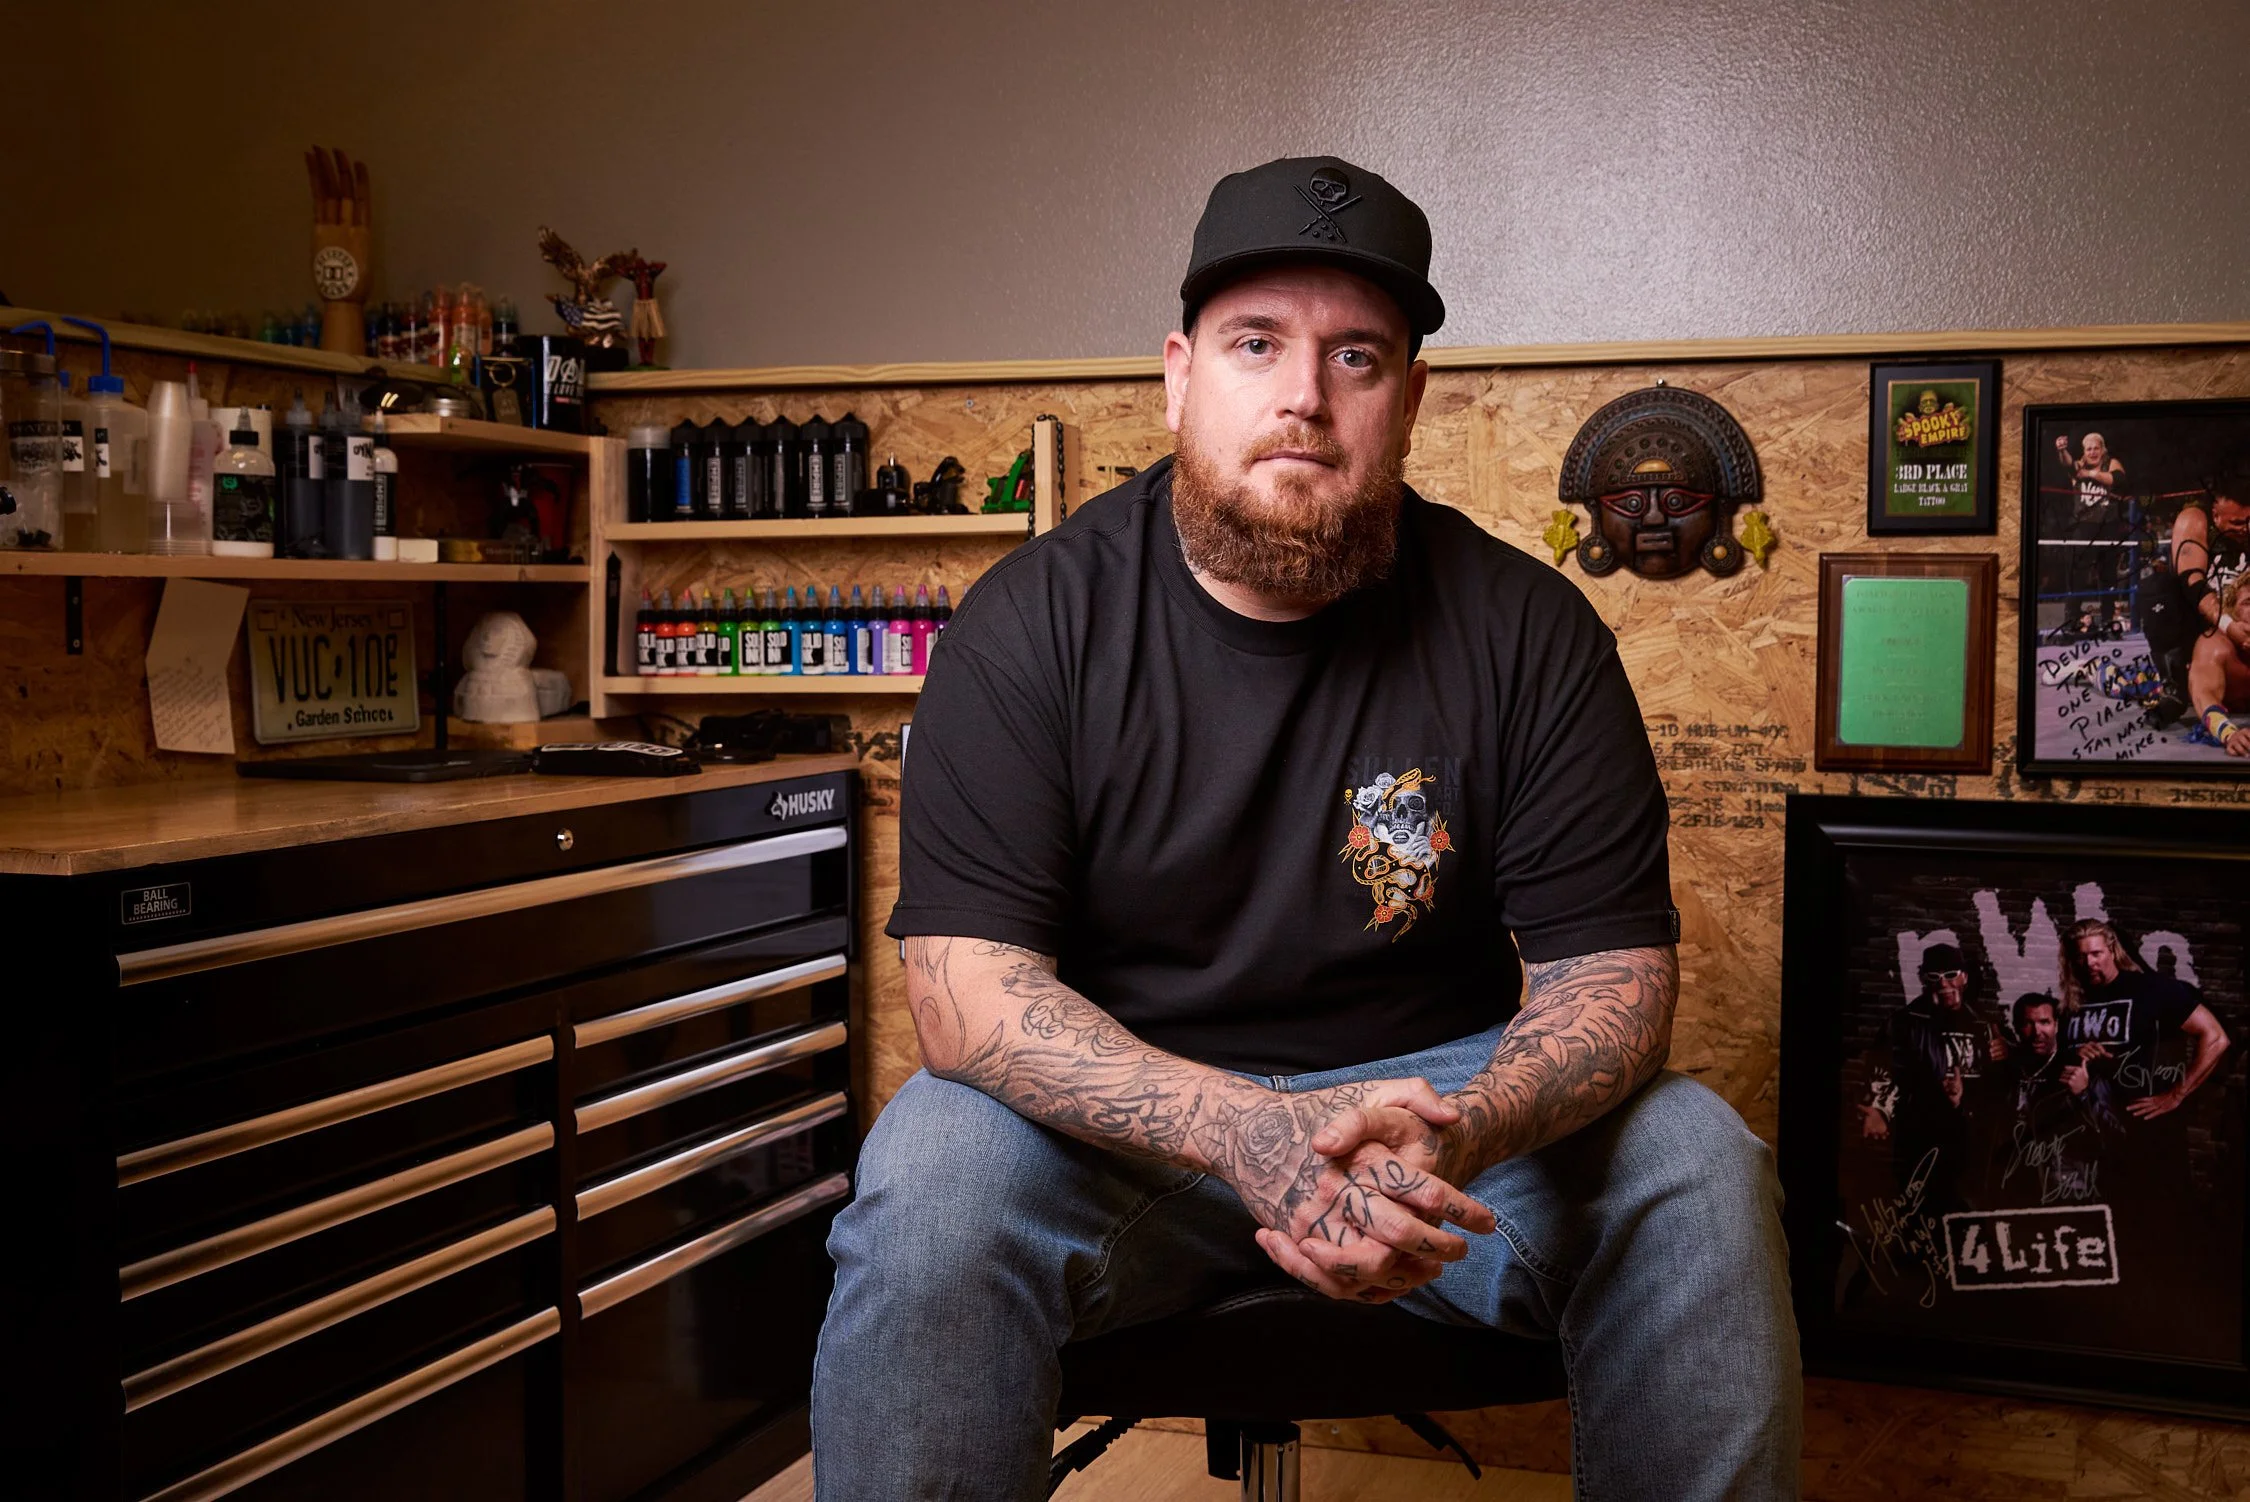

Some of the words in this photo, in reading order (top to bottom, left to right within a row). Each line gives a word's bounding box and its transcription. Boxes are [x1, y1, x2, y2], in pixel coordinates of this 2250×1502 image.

[1904, 411, 1961, 438] SPOOKY
[1921, 427, 1966, 444] EMPIRE
[1895, 464, 1922, 480] 3RD
[1926, 464, 1968, 480] PLACE
[1919, 496, 1946, 507] TATTOO
[292, 607, 328, 628] New
[330, 607, 373, 630] Jersey
[2057, 648, 2122, 693] TATTOO
[2058, 688, 2091, 718] ONE
[295, 708, 340, 727] Garden
[2072, 737, 2112, 760] STAY
[788, 789, 836, 817] HUSKY
[133, 897, 179, 916] BEARING
[143, 888, 169, 902] BALL
[2067, 1008, 2120, 1040] nWo
